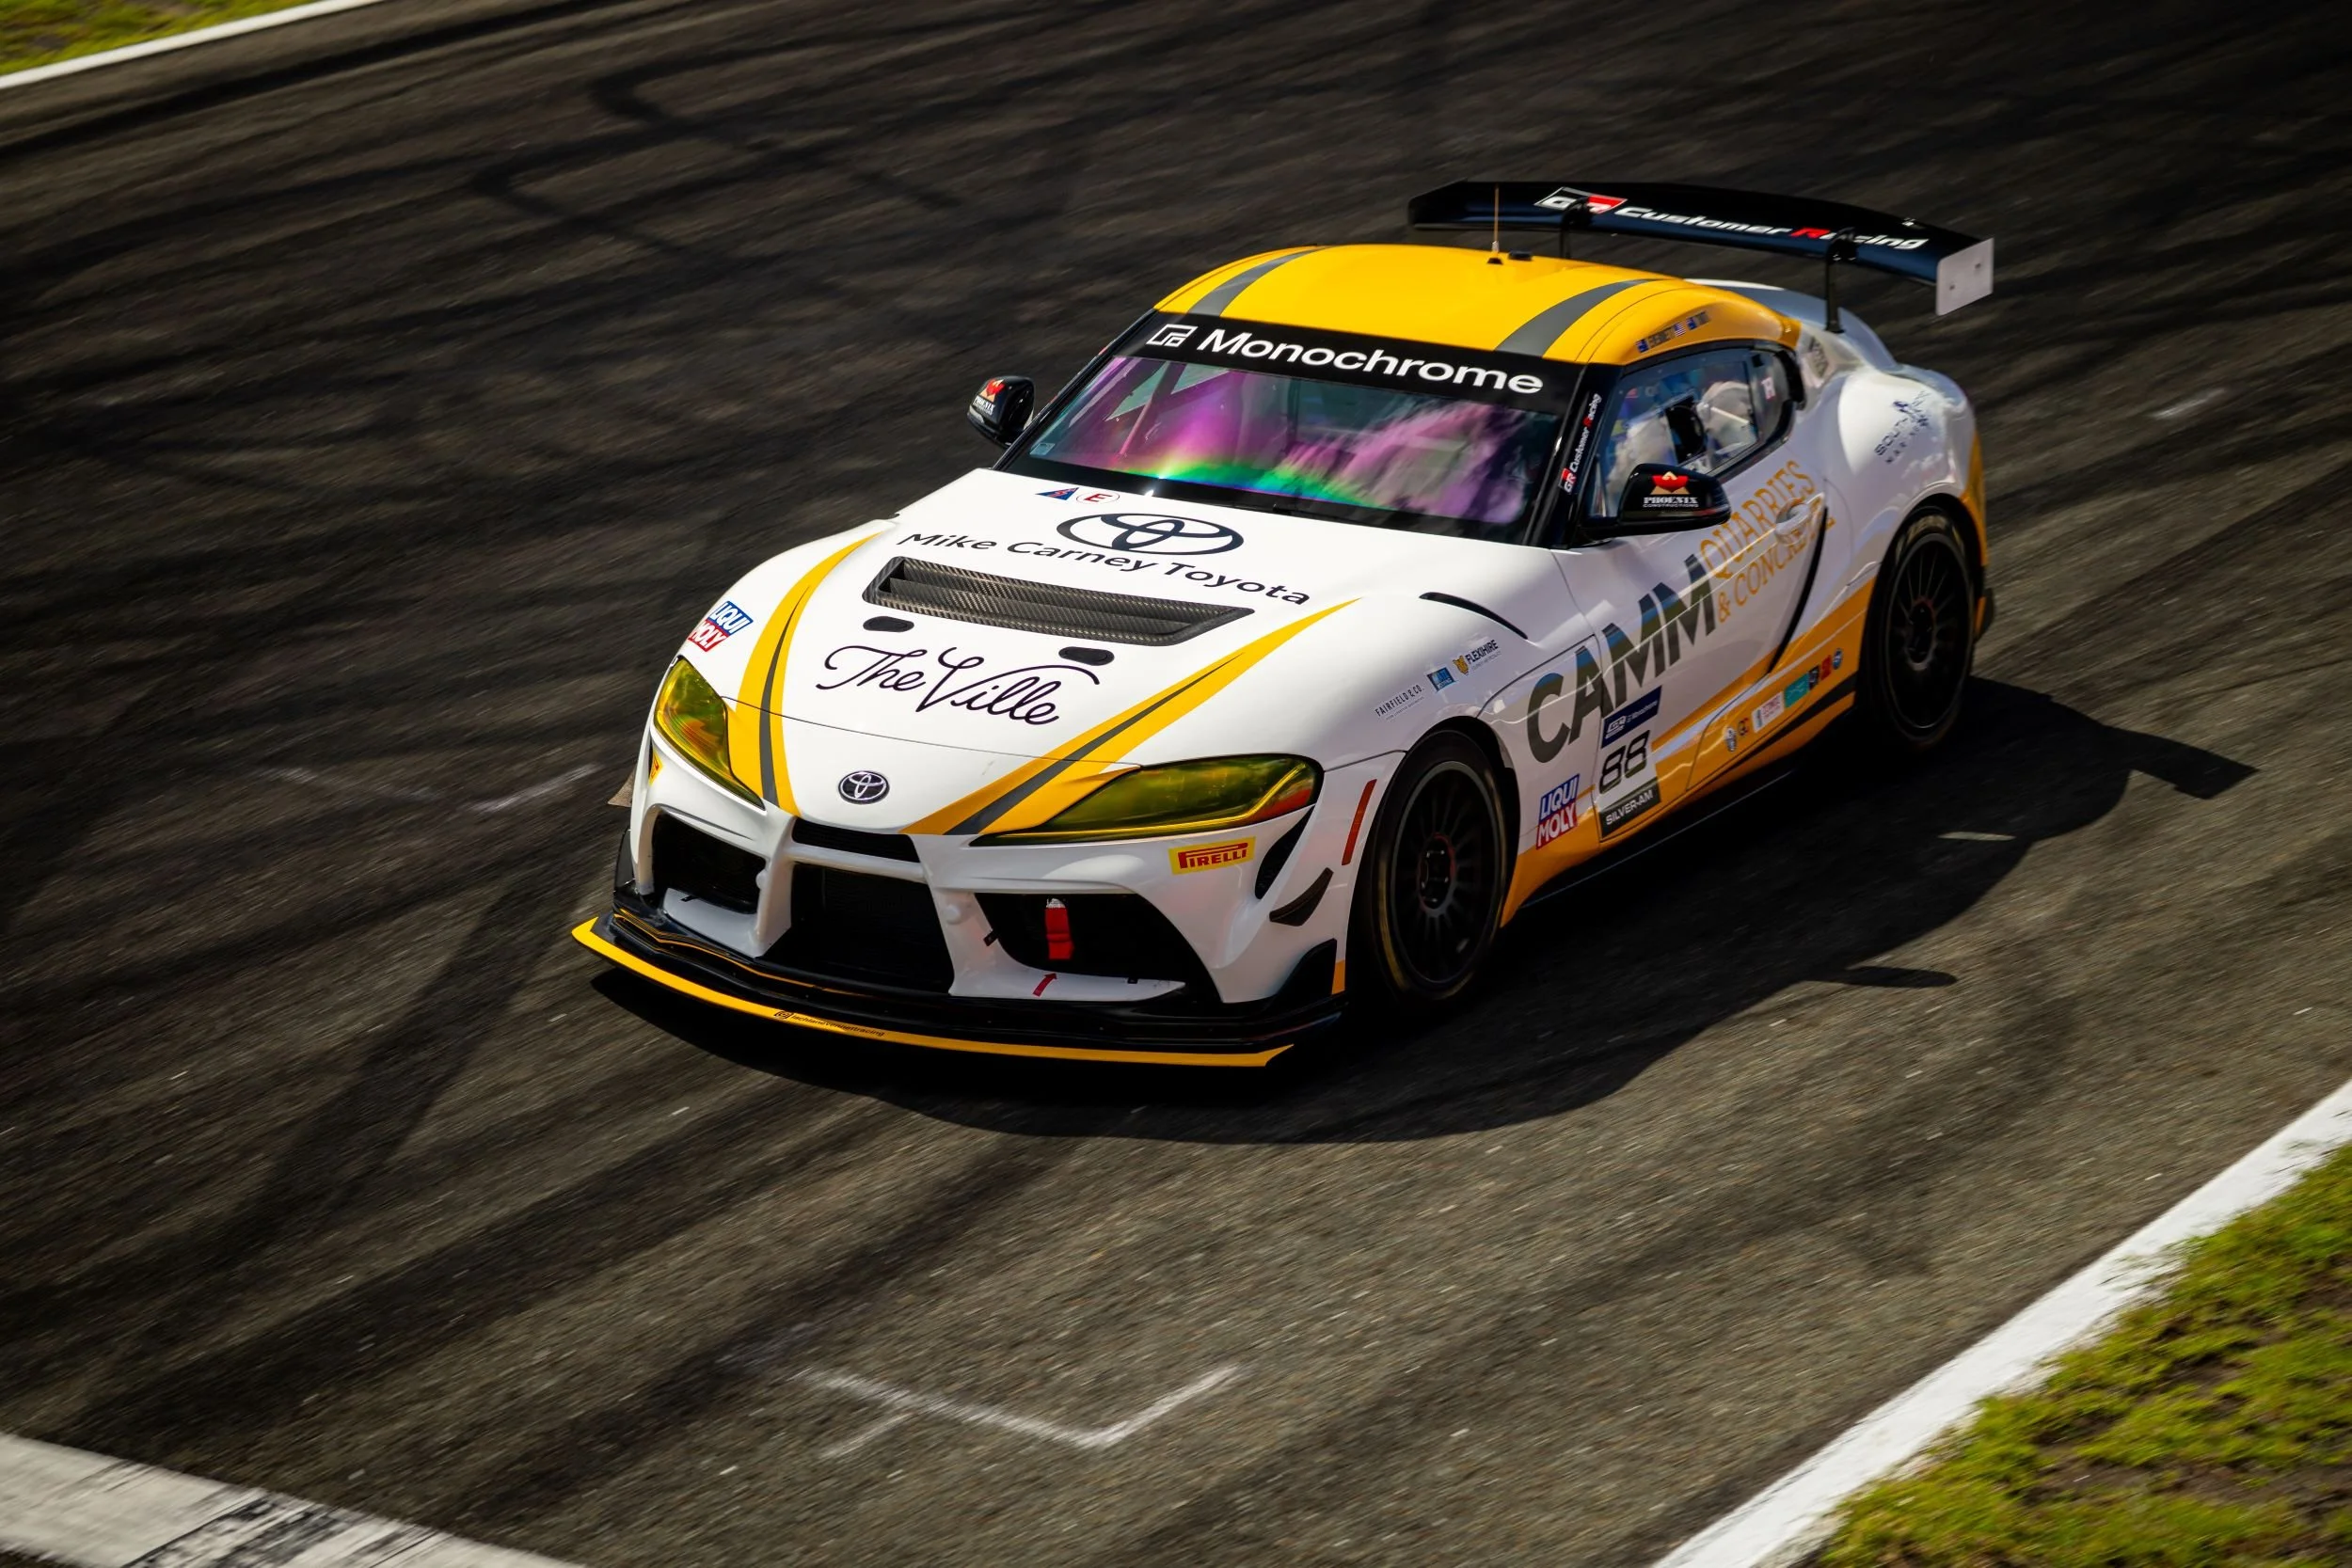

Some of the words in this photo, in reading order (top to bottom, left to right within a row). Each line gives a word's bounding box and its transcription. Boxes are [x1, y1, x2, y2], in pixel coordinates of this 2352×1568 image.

[1614, 207, 1792, 235] Customer
[1197, 329, 1544, 394] Monochrome
[1084, 493, 1113, 502] E
[1700, 460, 1816, 580] QUARRIES
[897, 533, 997, 550] Mike
[1007, 542, 1158, 572] Carney
[1165, 562, 1311, 606] Toyota
[1718, 592, 1731, 623] &
[1734, 508, 1836, 607] CONC
[690, 621, 727, 648] MOLY
[709, 602, 752, 634] LIQUI
[1465, 640, 1499, 664] FLEXIHIRE
[1527, 553, 1716, 763] CAMM
[816, 645, 928, 691] The
[915, 646, 1100, 725] Ville
[1375, 692, 1409, 717] FAIRFIELD
[1407, 689, 1415, 698] &
[1599, 730, 1650, 794] 88
[1540, 777, 1579, 820] LIQUI
[1606, 789, 1653, 825] SILVER-AM
[1537, 802, 1576, 847] MOLY
[1178, 843, 1248, 869] PIRELLI
